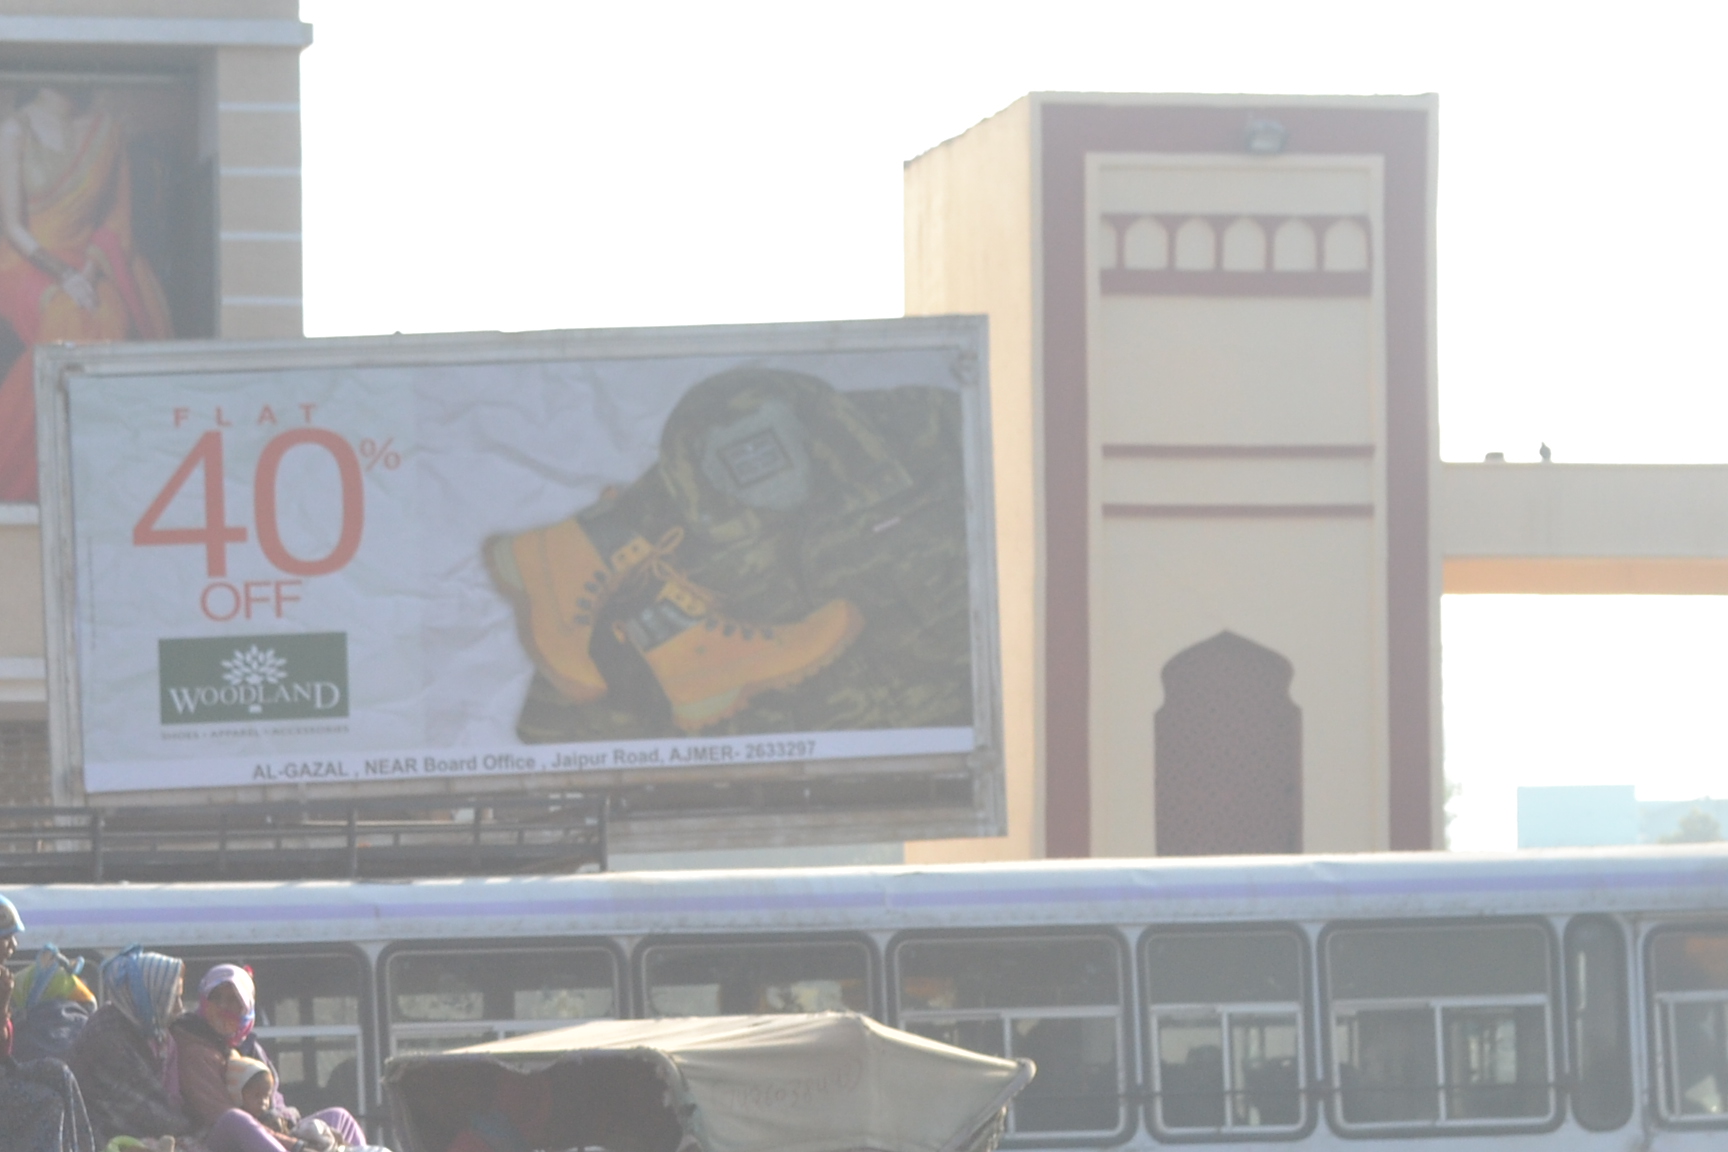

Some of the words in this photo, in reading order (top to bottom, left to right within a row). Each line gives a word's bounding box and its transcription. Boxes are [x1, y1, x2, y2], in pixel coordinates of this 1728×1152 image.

[173, 403, 319, 428] FLAT
[200, 578, 304, 622] OFF
[169, 680, 341, 715] WOODLAND
[364, 757, 419, 775] NEAR
[424, 754, 477, 772] Board
[482, 753, 536, 771] Office
[552, 751, 607, 771] Jaipur
